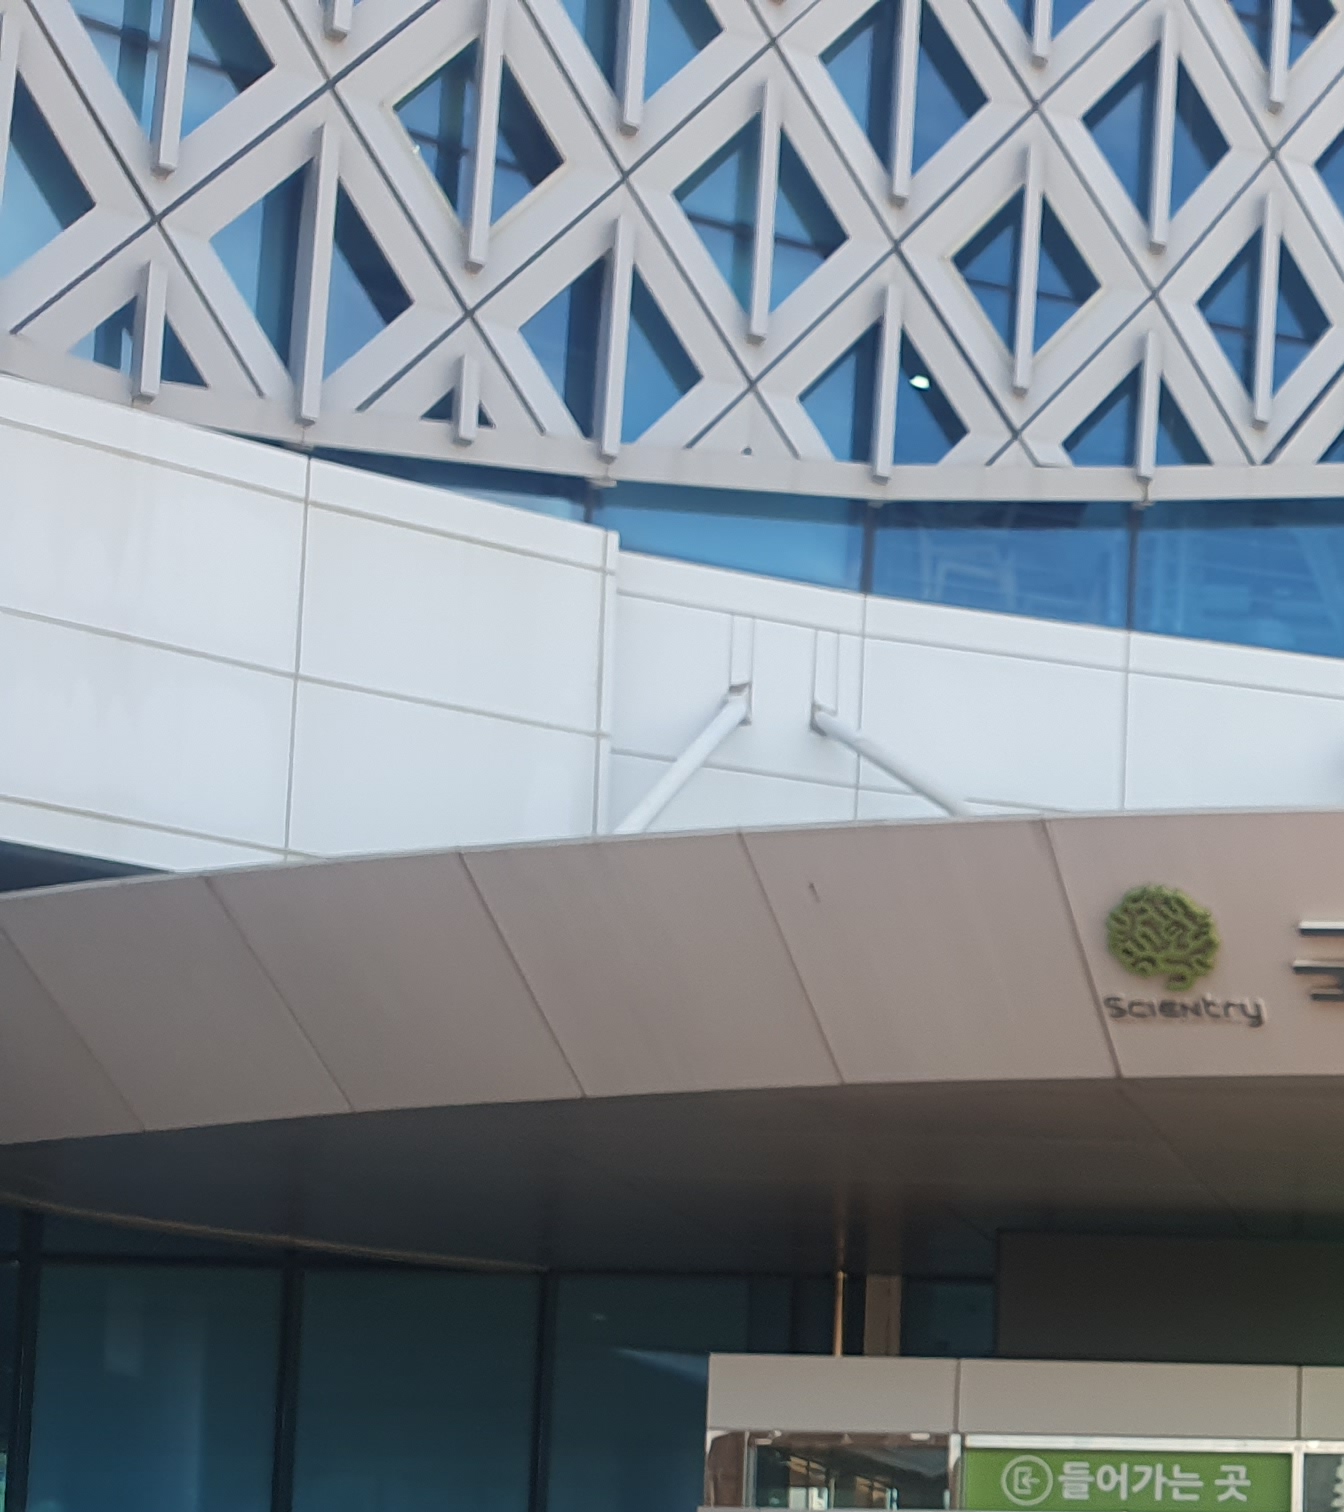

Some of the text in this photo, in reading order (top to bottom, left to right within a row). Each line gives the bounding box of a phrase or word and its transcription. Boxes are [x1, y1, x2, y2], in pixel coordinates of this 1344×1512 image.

[1103, 994, 1266, 1028] Scientry
[1058, 1462, 1252, 1504] 들어가는 곳
